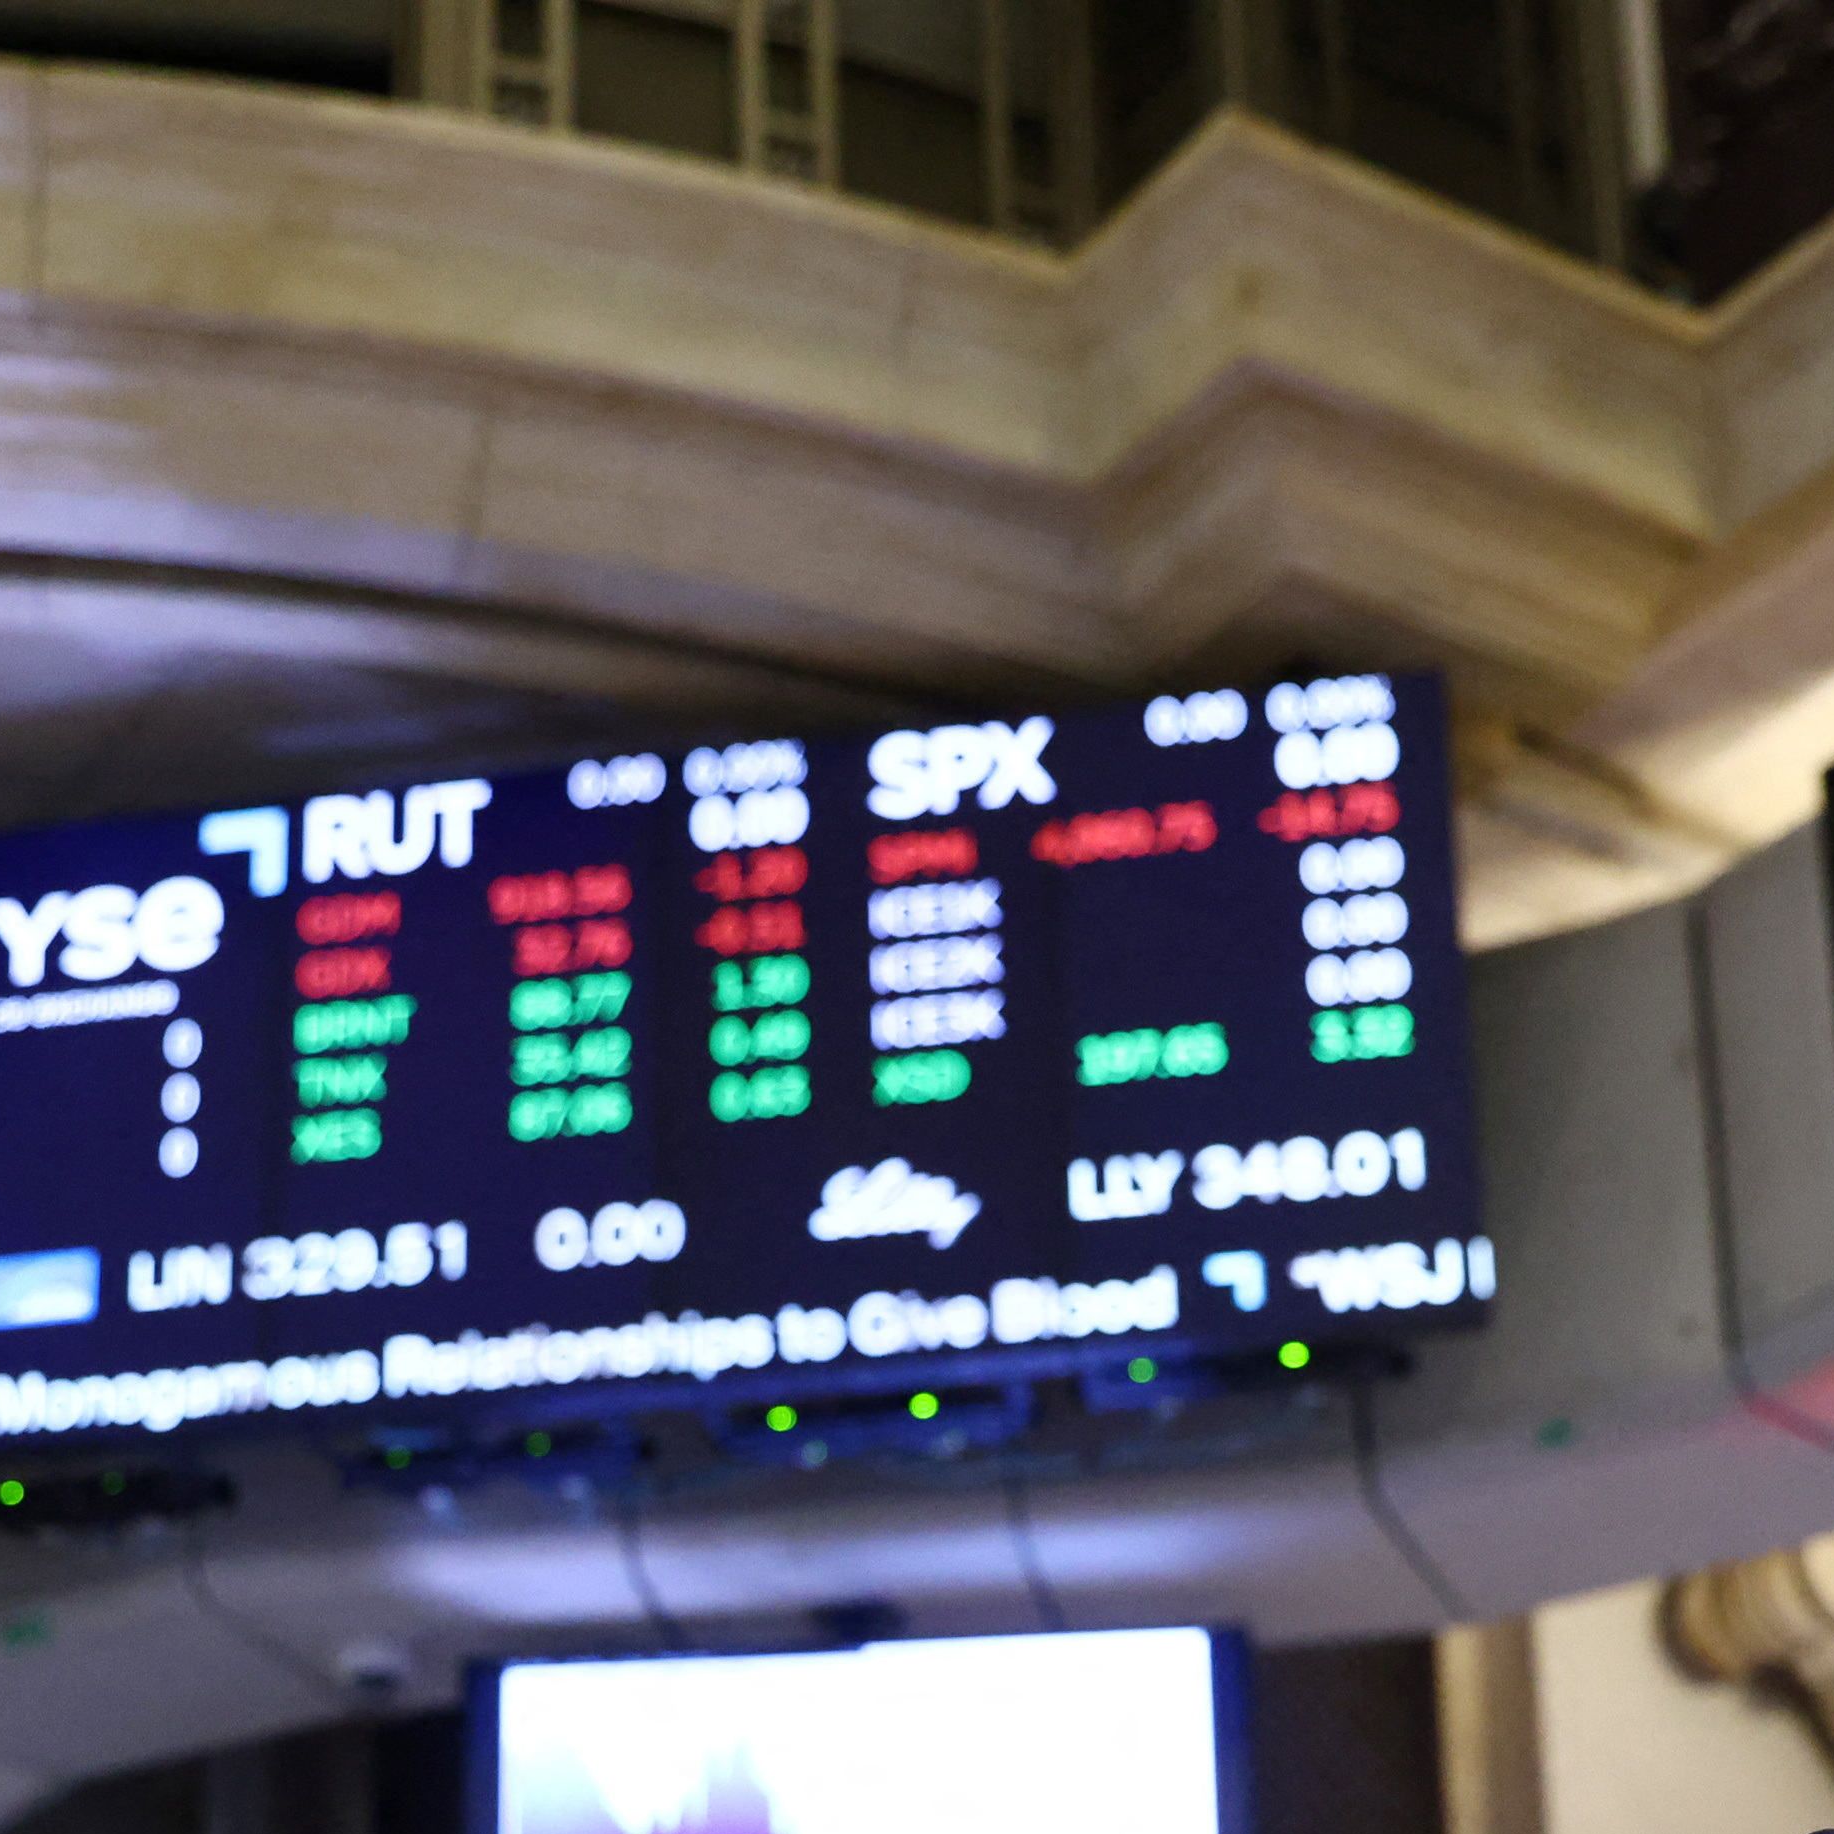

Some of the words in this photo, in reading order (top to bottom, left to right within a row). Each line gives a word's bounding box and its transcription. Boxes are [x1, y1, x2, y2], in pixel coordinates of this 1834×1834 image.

[867, 715, 1057, 820] SPX
[1144, 688, 1249, 747] 0.00
[301, 777, 494, 884] RUT
[567, 752, 667, 810] 0.00
[1299, 836, 1406, 894] 0.00
[1302, 891, 1409, 951] 0.00
[1305, 947, 1413, 1006] 0.00
[162, 1017, 204, 1070] 0
[159, 1071, 202, 1123] 0
[157, 1125, 200, 1178] 0
[127, 1242, 234, 1313] LIN
[534, 1198, 687, 1272] 0.00
[1066, 1148, 1186, 1222] LLY
[381, 1307, 776, 1398] Relationships
[775, 1303, 848, 1363] to
[847, 1289, 990, 1359] Give
[988, 1262, 1180, 1345] Blood
